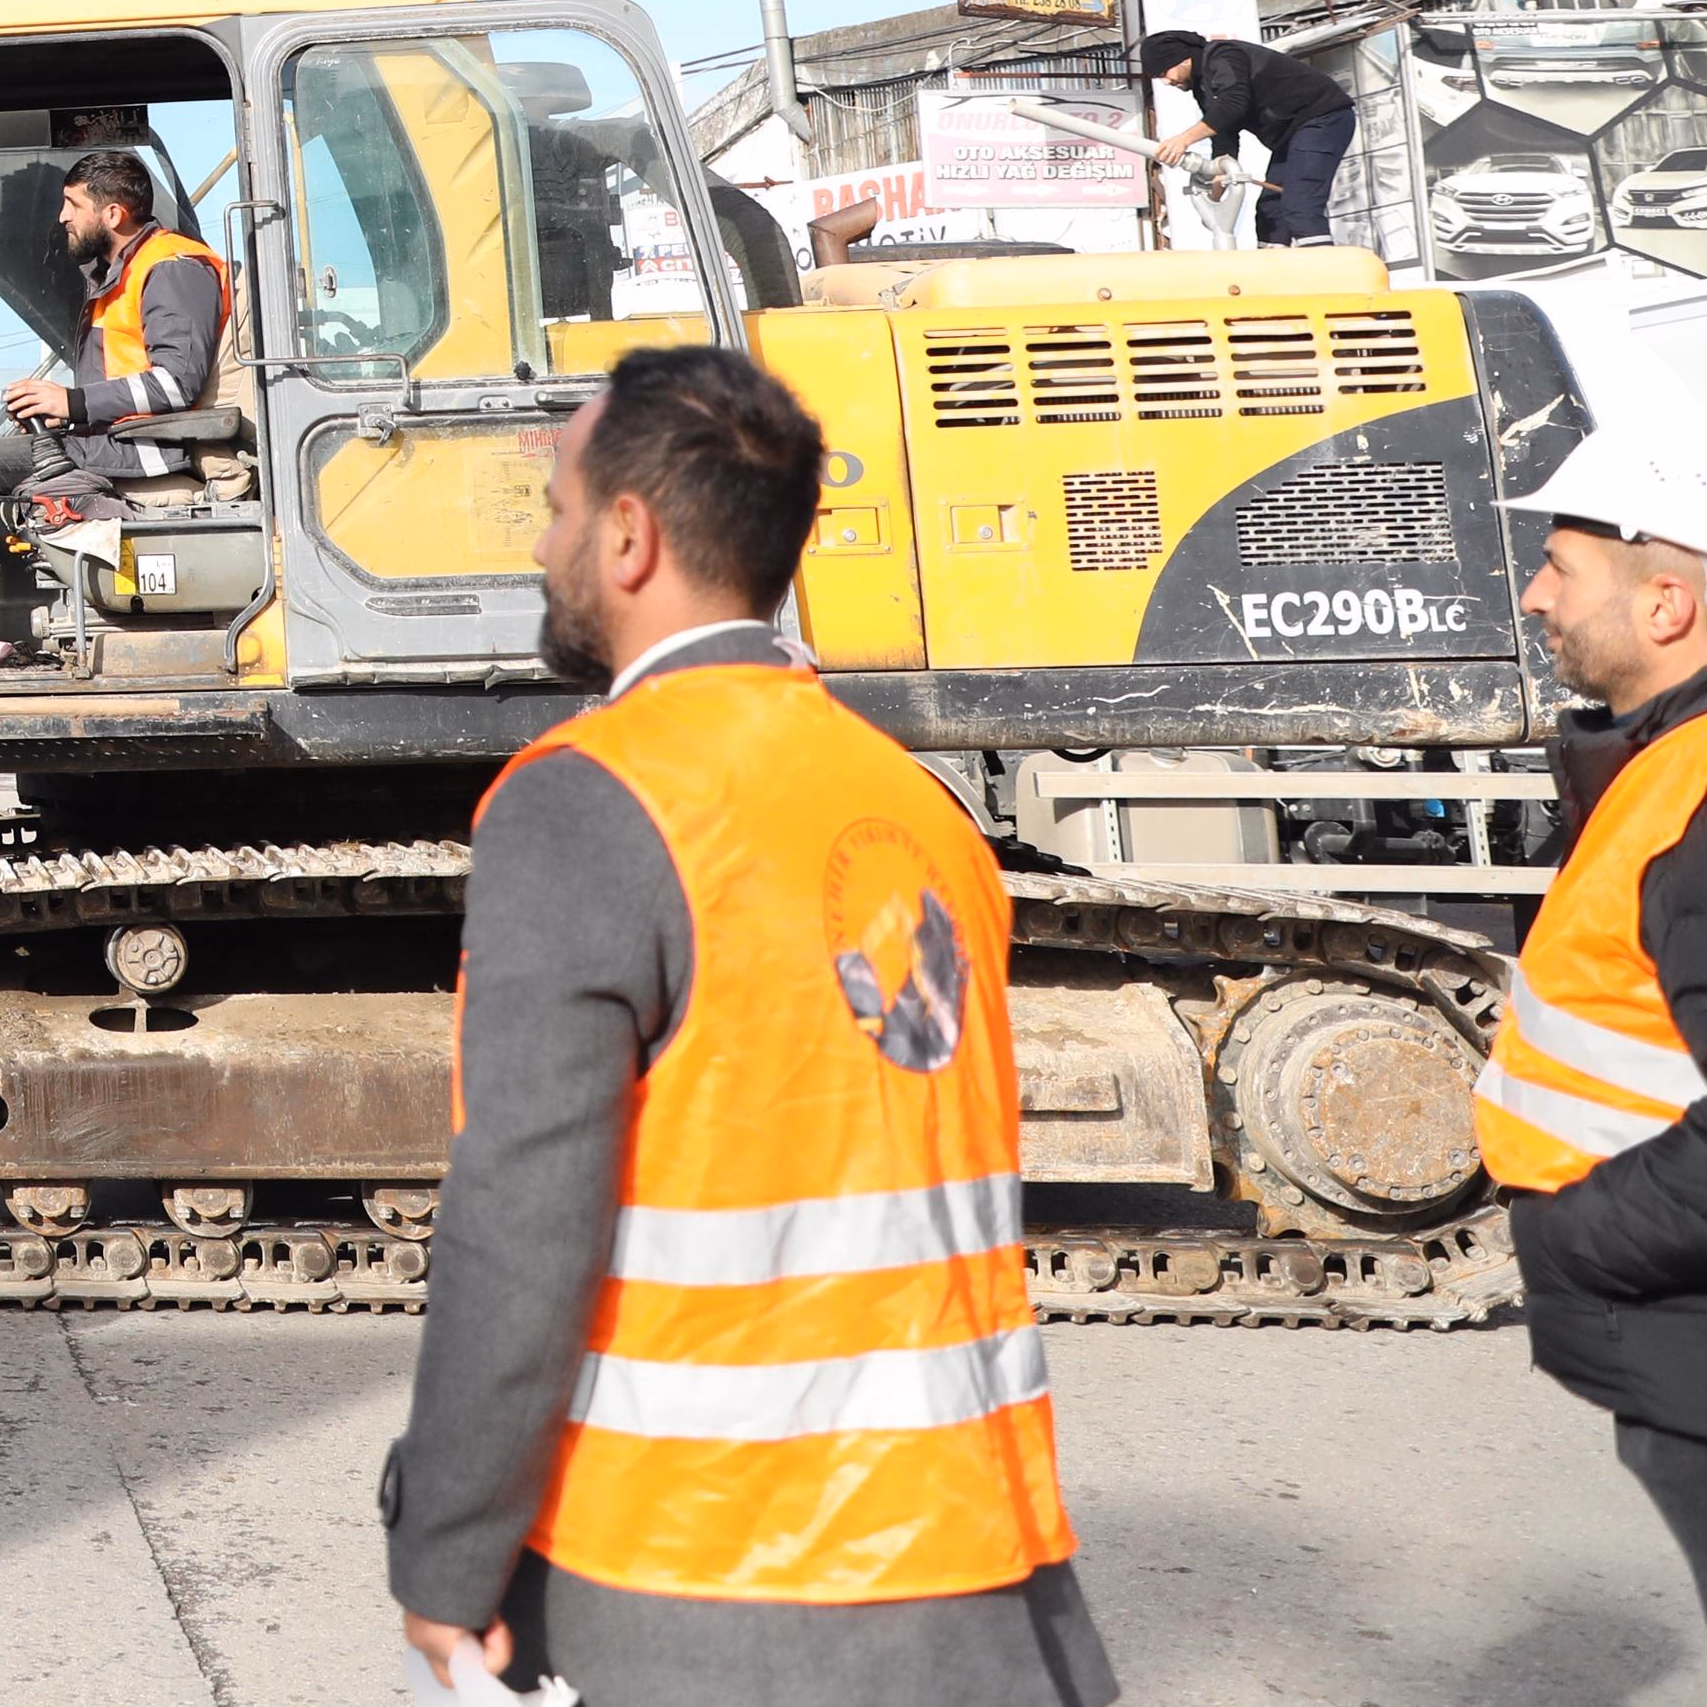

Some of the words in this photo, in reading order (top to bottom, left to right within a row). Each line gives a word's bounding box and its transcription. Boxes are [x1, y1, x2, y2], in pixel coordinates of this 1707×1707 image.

[953, 145, 997, 161] OTO
[998, 145, 1116, 161] AKSESUAR
[936, 163, 990, 180] HIZLI
[994, 161, 1037, 180] YAĞ
[1042, 161, 1135, 182] DEĞİŞİM
[140, 572, 167, 593] 104
